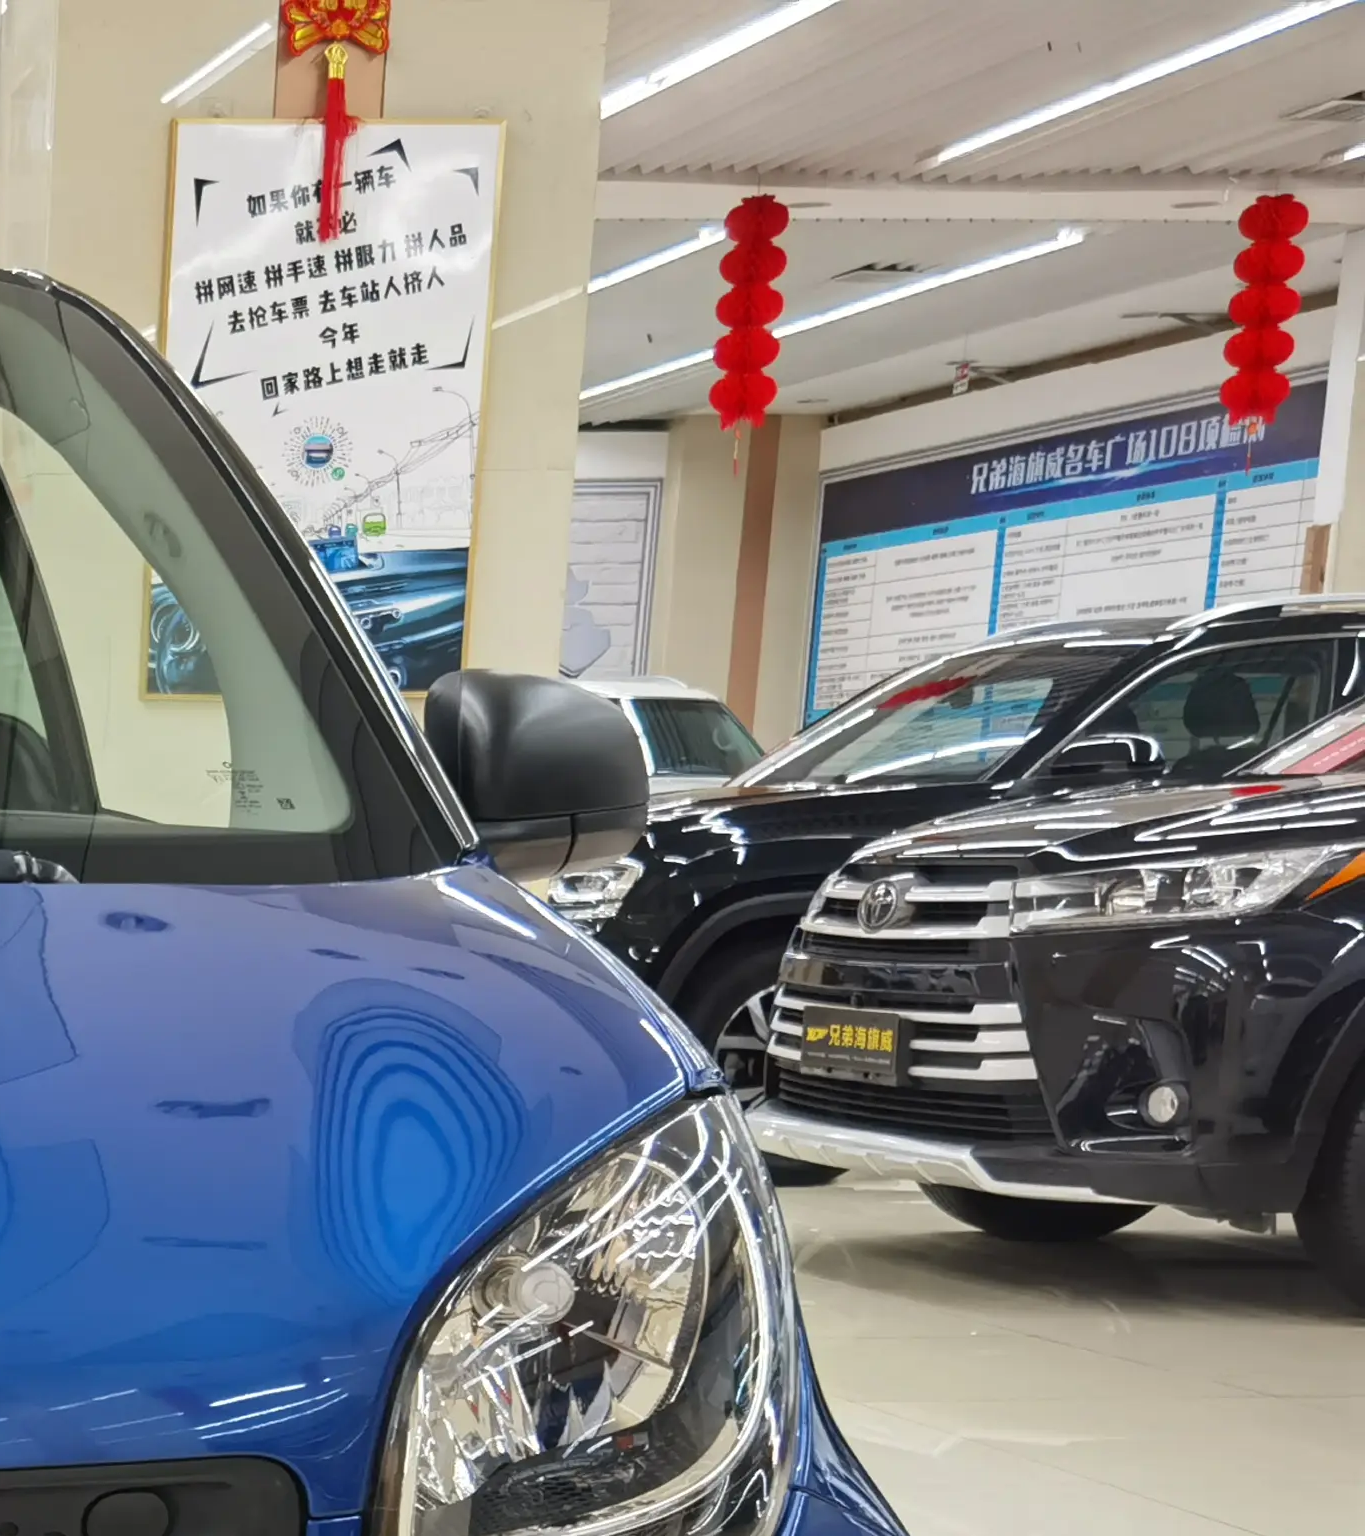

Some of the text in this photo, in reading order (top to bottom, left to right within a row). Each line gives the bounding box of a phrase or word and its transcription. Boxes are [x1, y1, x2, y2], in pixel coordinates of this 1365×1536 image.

[294, 211, 358, 245] 就必
[194, 223, 467, 304] 拼网速 拼手速 拼眼力 拼人品
[228, 266, 445, 334] 去抢车票 去车站人挤人
[319, 322, 360, 349] 今年
[261, 343, 430, 401] 回家路上想走就走
